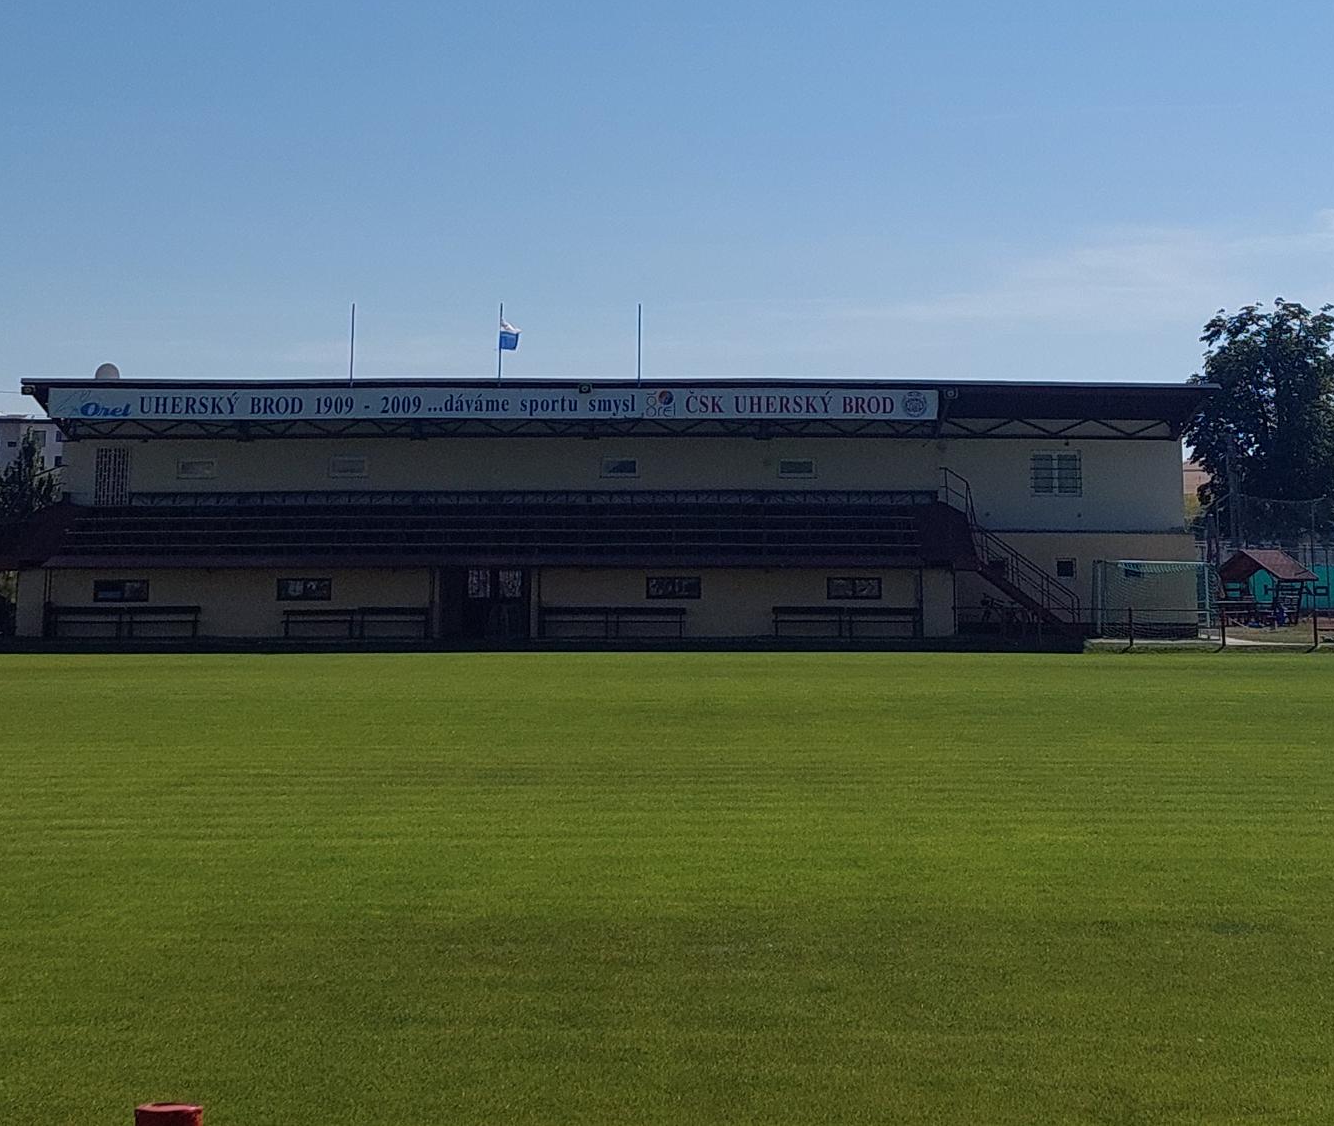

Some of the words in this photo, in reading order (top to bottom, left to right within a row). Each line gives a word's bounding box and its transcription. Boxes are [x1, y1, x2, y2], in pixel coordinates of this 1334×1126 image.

[80, 402, 132, 417] Orel
[139, 391, 240, 415] UHERSKÝ
[250, 396, 303, 415] BROD
[315, 396, 355, 415] 1909
[381, 395, 422, 415] 2009
[519, 396, 578, 416] sportu
[588, 394, 636, 416] smysl
[685, 389, 725, 414] ČSK
[734, 390, 833, 415] UHERSKÝ
[842, 395, 895, 415] BROD
